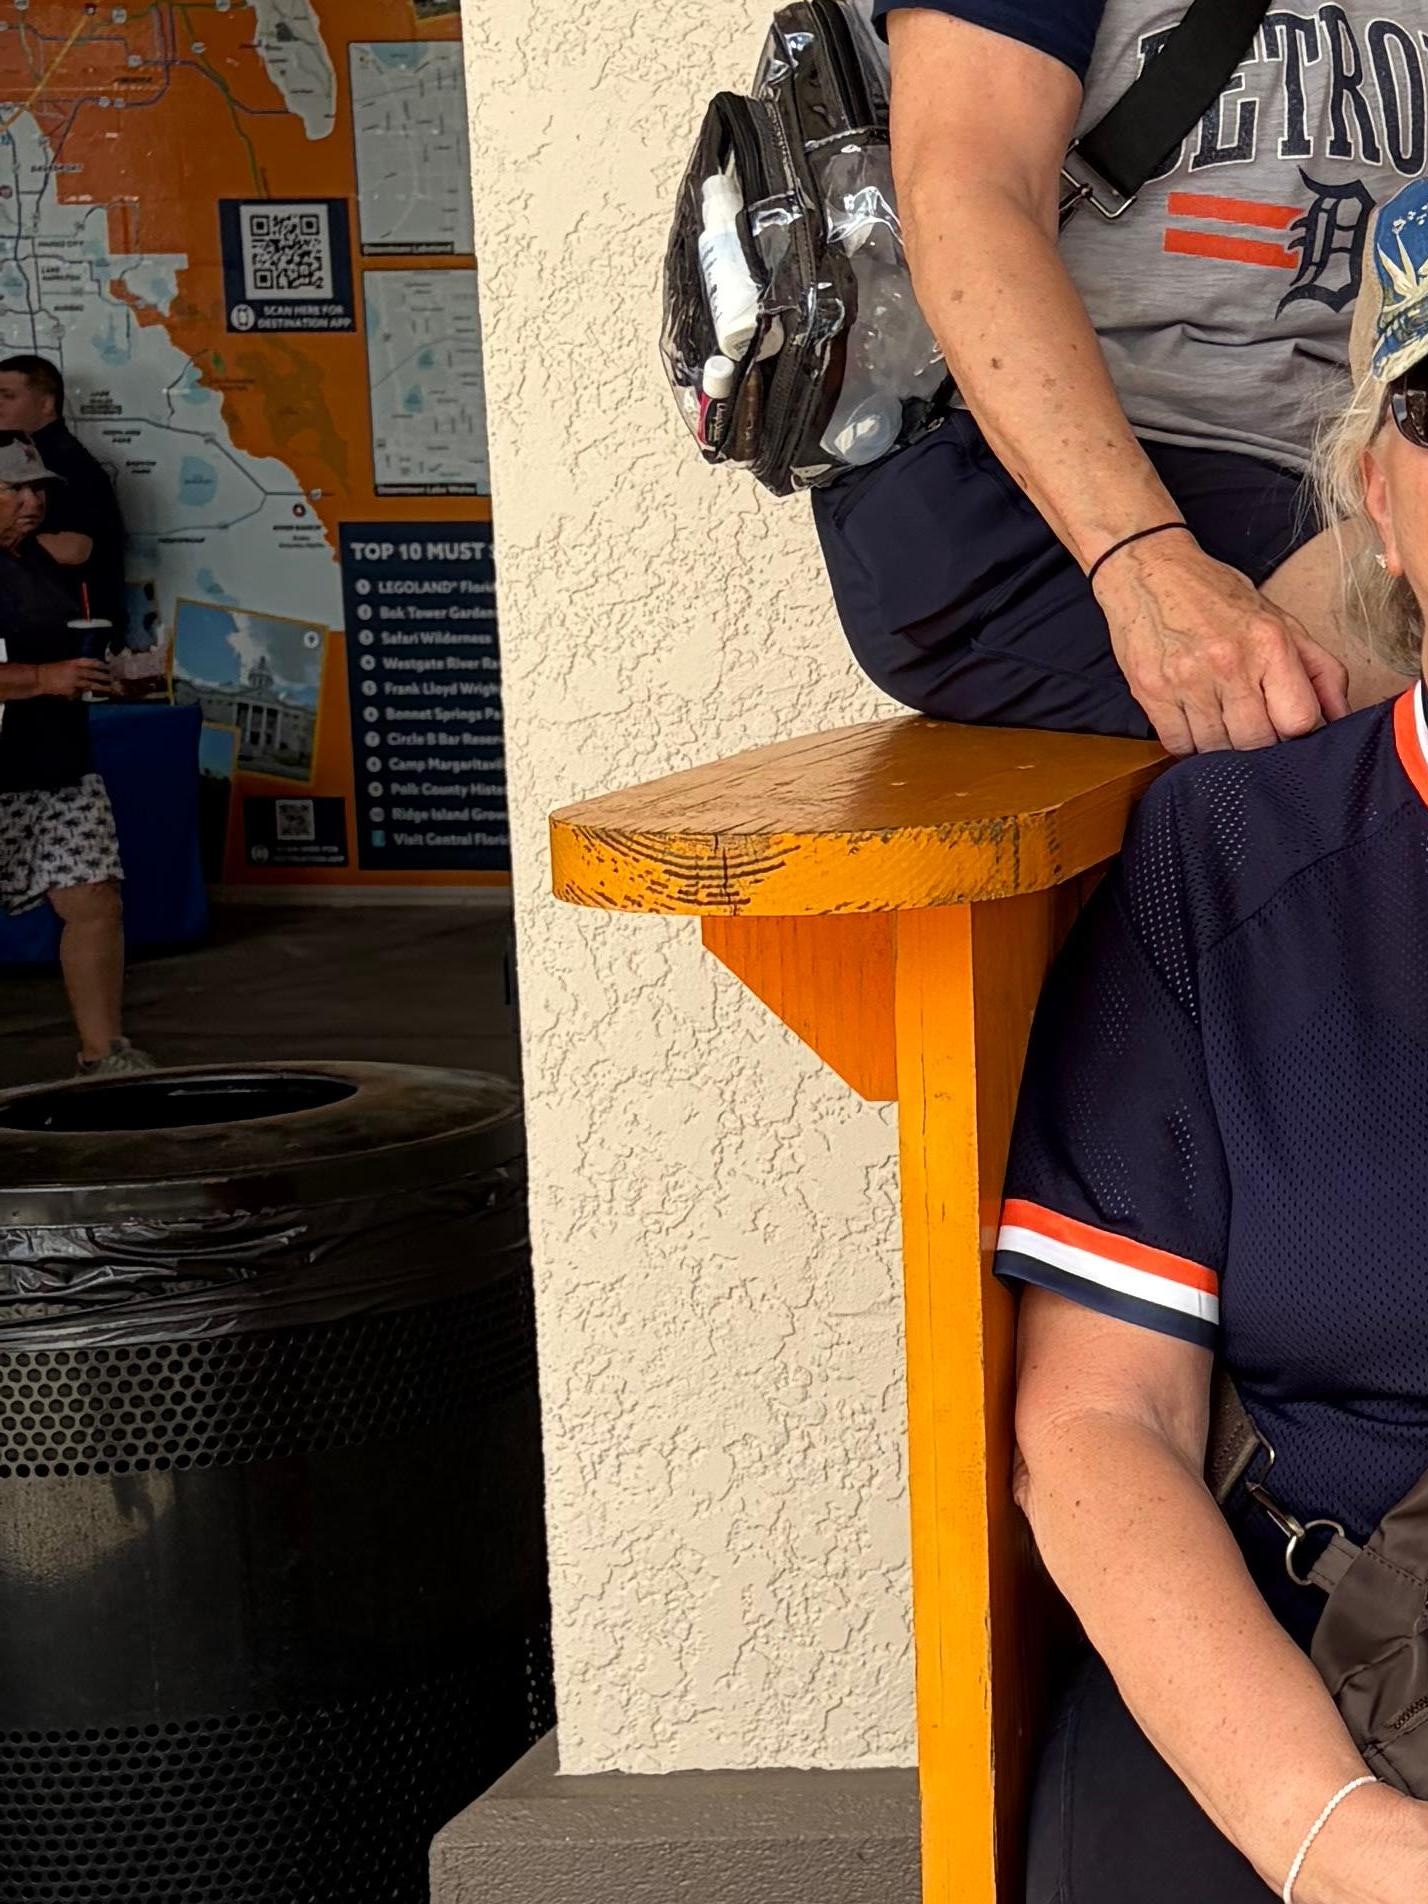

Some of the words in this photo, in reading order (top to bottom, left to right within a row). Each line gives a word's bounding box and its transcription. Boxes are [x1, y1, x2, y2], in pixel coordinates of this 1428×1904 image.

[350, 542, 395, 561] TOP
[398, 542, 423, 561] 10
[426, 542, 486, 561] MUST
[407, 606, 448, 620] Tower
[380, 631, 418, 645] Safari
[420, 631, 493, 646] Wilderness
[381, 656, 444, 673] Westgate
[446, 656, 480, 670] River
[481, 657, 500, 670] Ra
[383, 681, 421, 696] Frank
[422, 681, 458, 698] Lloyd
[434, 707, 482, 724] Springs
[386, 732, 425, 746] Circle
[438, 732, 461, 746] Bar
[388, 757, 426, 773] Camp
[390, 782, 420, 796] Polk
[421, 782, 468, 798] County
[391, 807, 430, 824] Ridge
[431, 807, 471, 821] Island
[426, 832, 473, 845] Central
